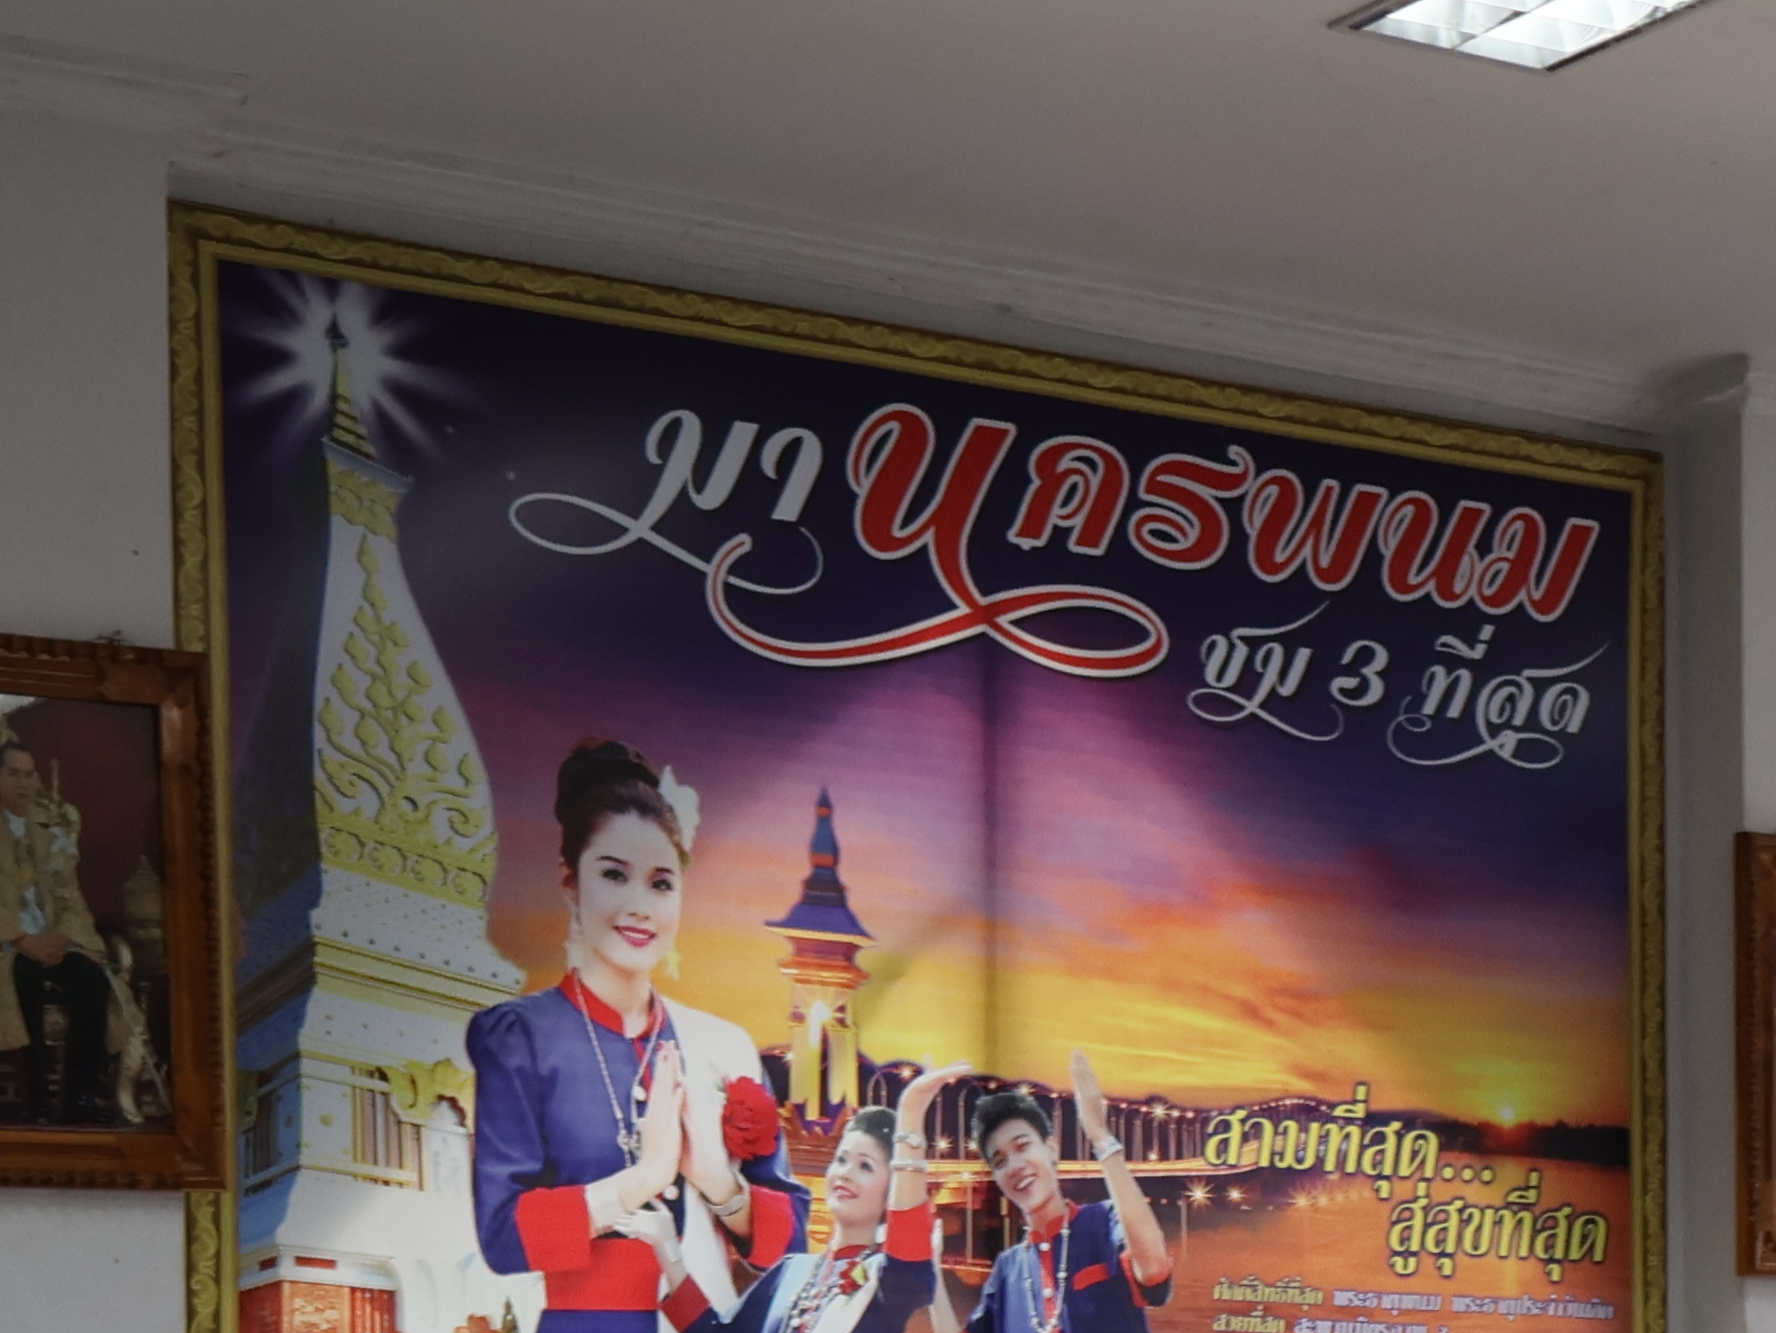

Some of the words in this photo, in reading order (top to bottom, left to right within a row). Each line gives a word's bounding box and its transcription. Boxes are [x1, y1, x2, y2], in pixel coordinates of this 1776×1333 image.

[707, 402, 1599, 680] นครพนม
[1330, 640, 1391, 706] 3
[1387, 1170, 1610, 1283] สู่สุขที่สุด
